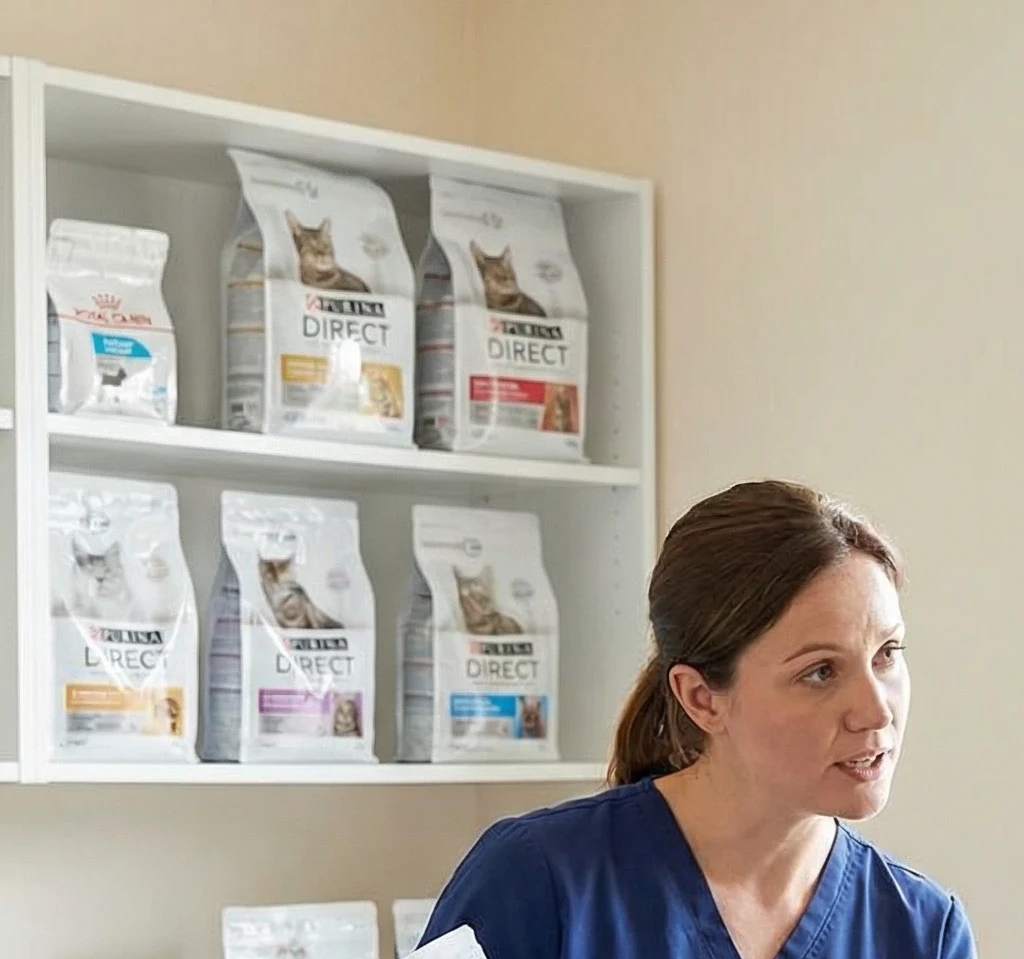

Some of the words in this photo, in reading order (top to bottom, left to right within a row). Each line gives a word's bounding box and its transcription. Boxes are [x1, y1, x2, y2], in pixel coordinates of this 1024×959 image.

[318, 297, 385, 317] PURINA
[302, 314, 390, 346] DIRECT
[487, 337, 568, 365] DIRECT
[100, 627, 163, 645] PURINA
[466, 659, 539, 679] DIRECT
